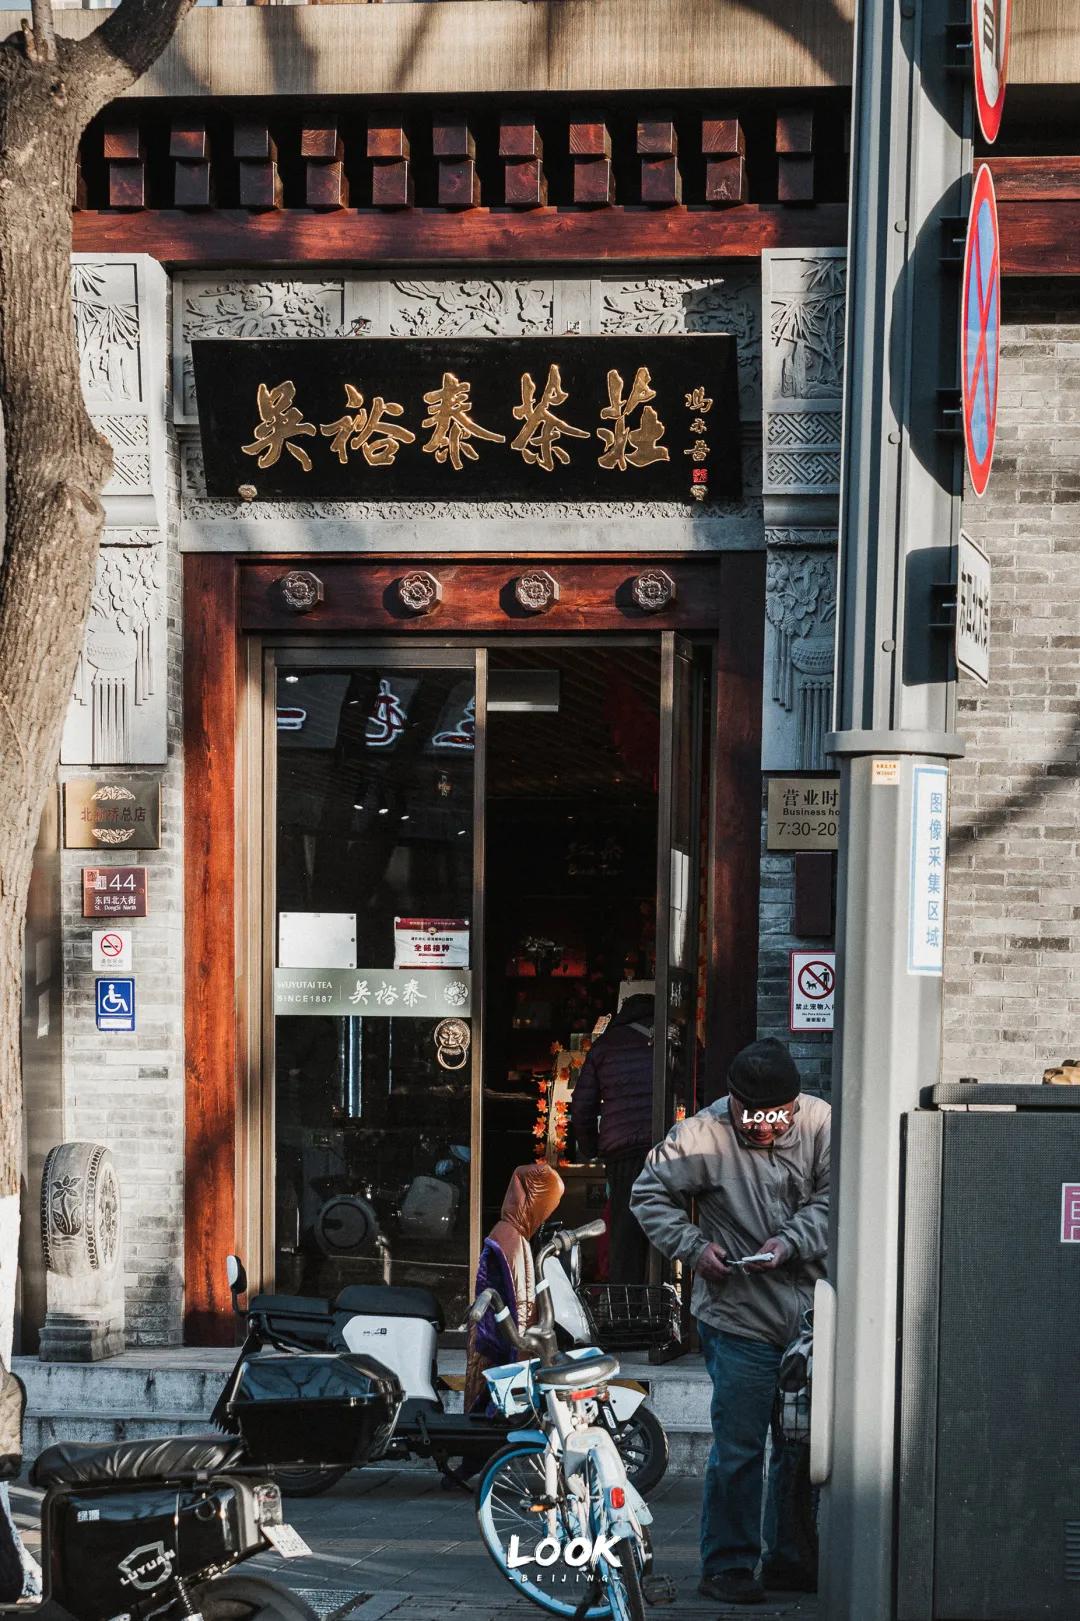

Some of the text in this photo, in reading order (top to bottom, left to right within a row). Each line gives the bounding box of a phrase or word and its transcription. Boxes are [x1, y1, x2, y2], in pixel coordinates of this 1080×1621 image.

[783, 789, 839, 806] 营业时
[783, 808, 826, 816] Business
[926, 792, 942, 947] 图像采集区域
[94, 895, 136, 904] 东四北大街
[120, 1549, 176, 1586] LUYUAN
